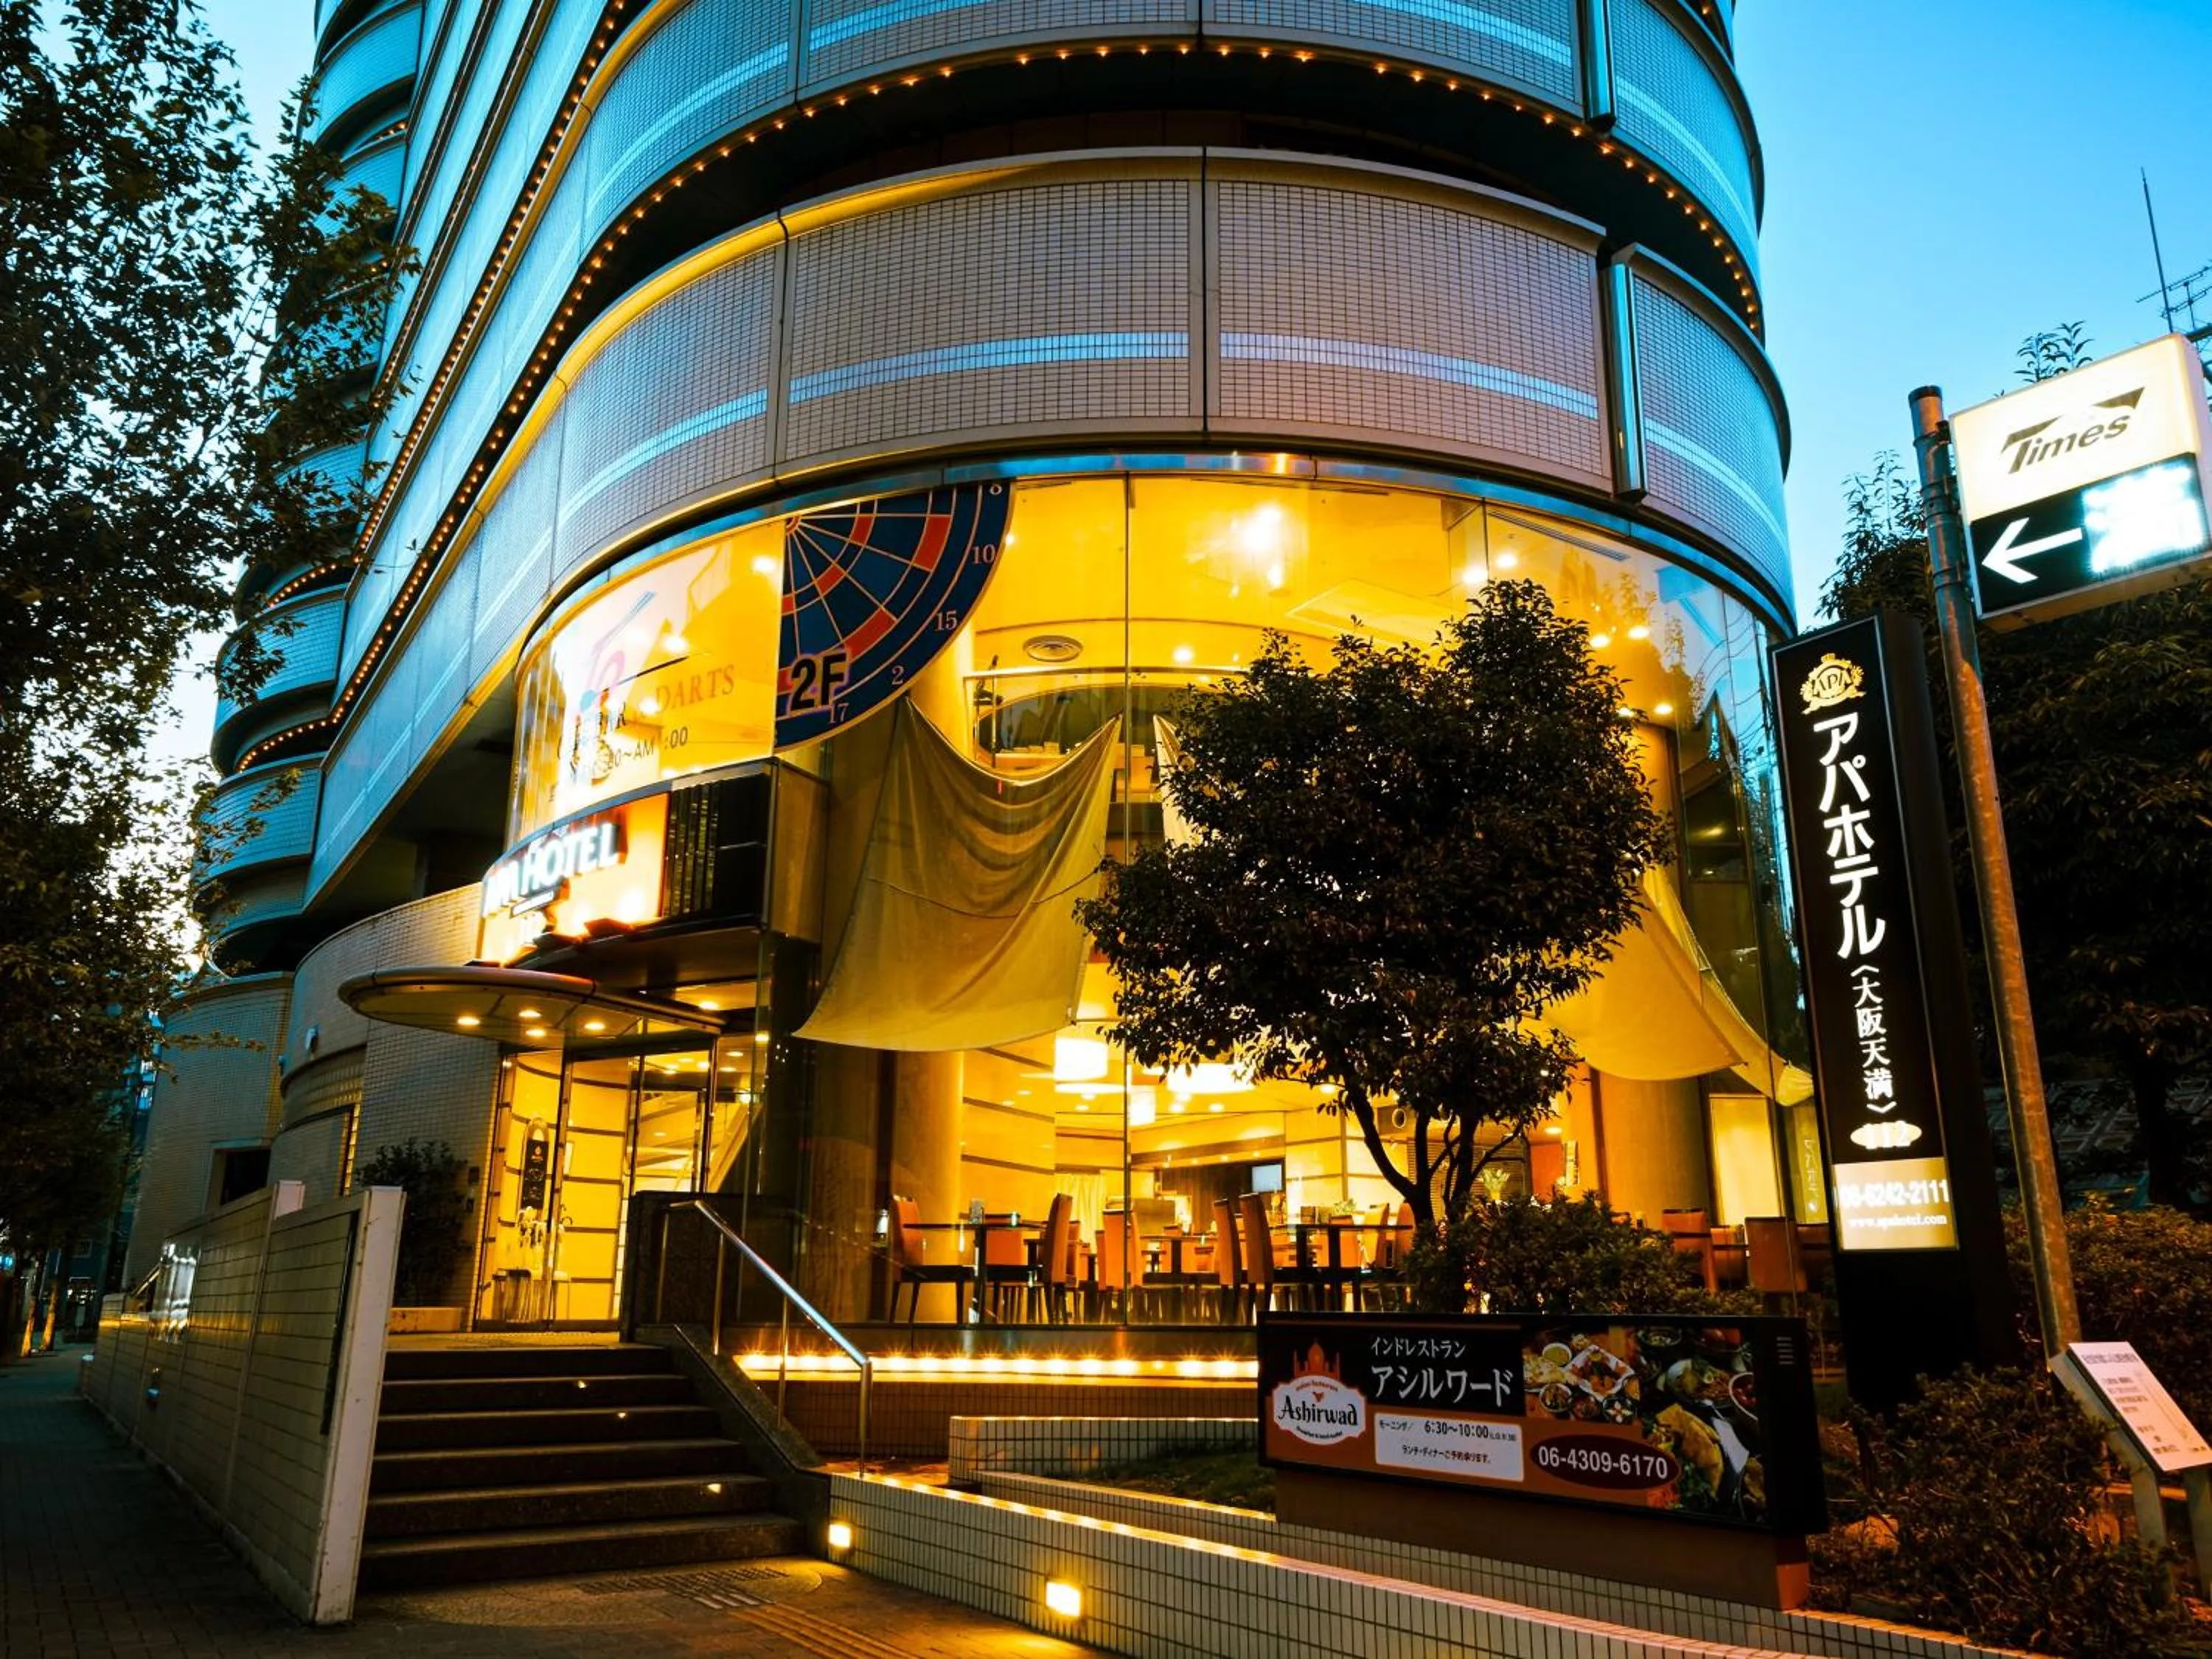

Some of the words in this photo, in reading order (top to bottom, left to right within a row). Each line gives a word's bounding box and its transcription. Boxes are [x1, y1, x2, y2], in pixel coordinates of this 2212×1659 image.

[2000, 413, 2131, 474] Times
[972, 544, 995, 564] 10
[935, 610, 958, 631] 15
[655, 664, 734, 712] DARTS
[790, 652, 848, 712] 2F
[891, 665, 905, 686] 2
[828, 702, 849, 724] 17
[1813, 712, 1885, 959] アパホテル
[520, 821, 619, 897] HOTEL
[1371, 1337, 1466, 1358] インドレストラン
[1371, 1366, 1513, 1408] アシルワード
[1278, 1394, 1358, 1426] Ashirwad
[1538, 1445, 1668, 1480] 06-4309-6170
